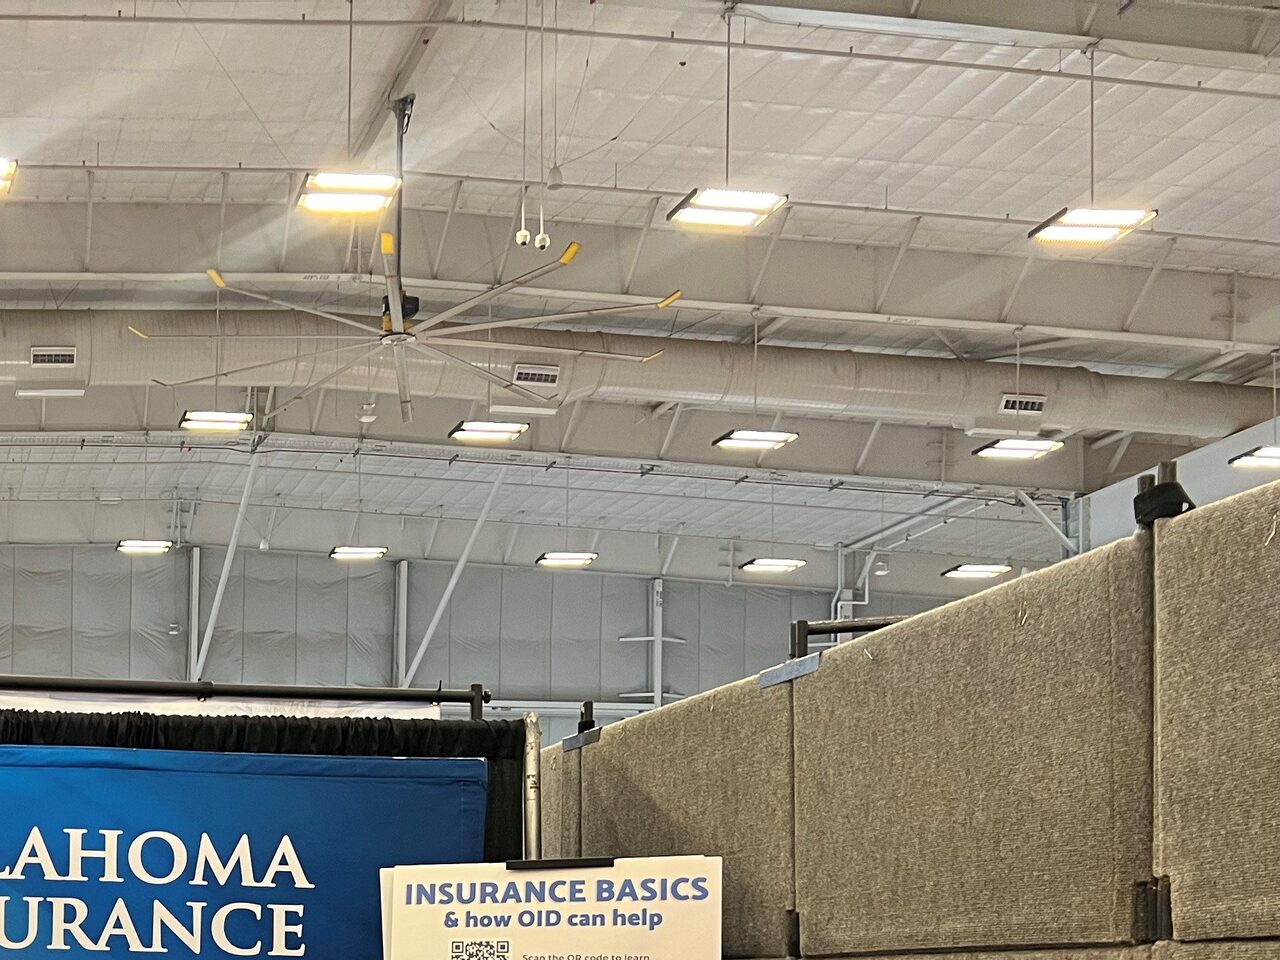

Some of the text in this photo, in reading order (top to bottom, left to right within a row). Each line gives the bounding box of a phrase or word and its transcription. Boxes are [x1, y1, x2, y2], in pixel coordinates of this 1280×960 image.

[405, 876, 709, 905] INSURANCE BASICS
[443, 907, 663, 931] & how OID can help
